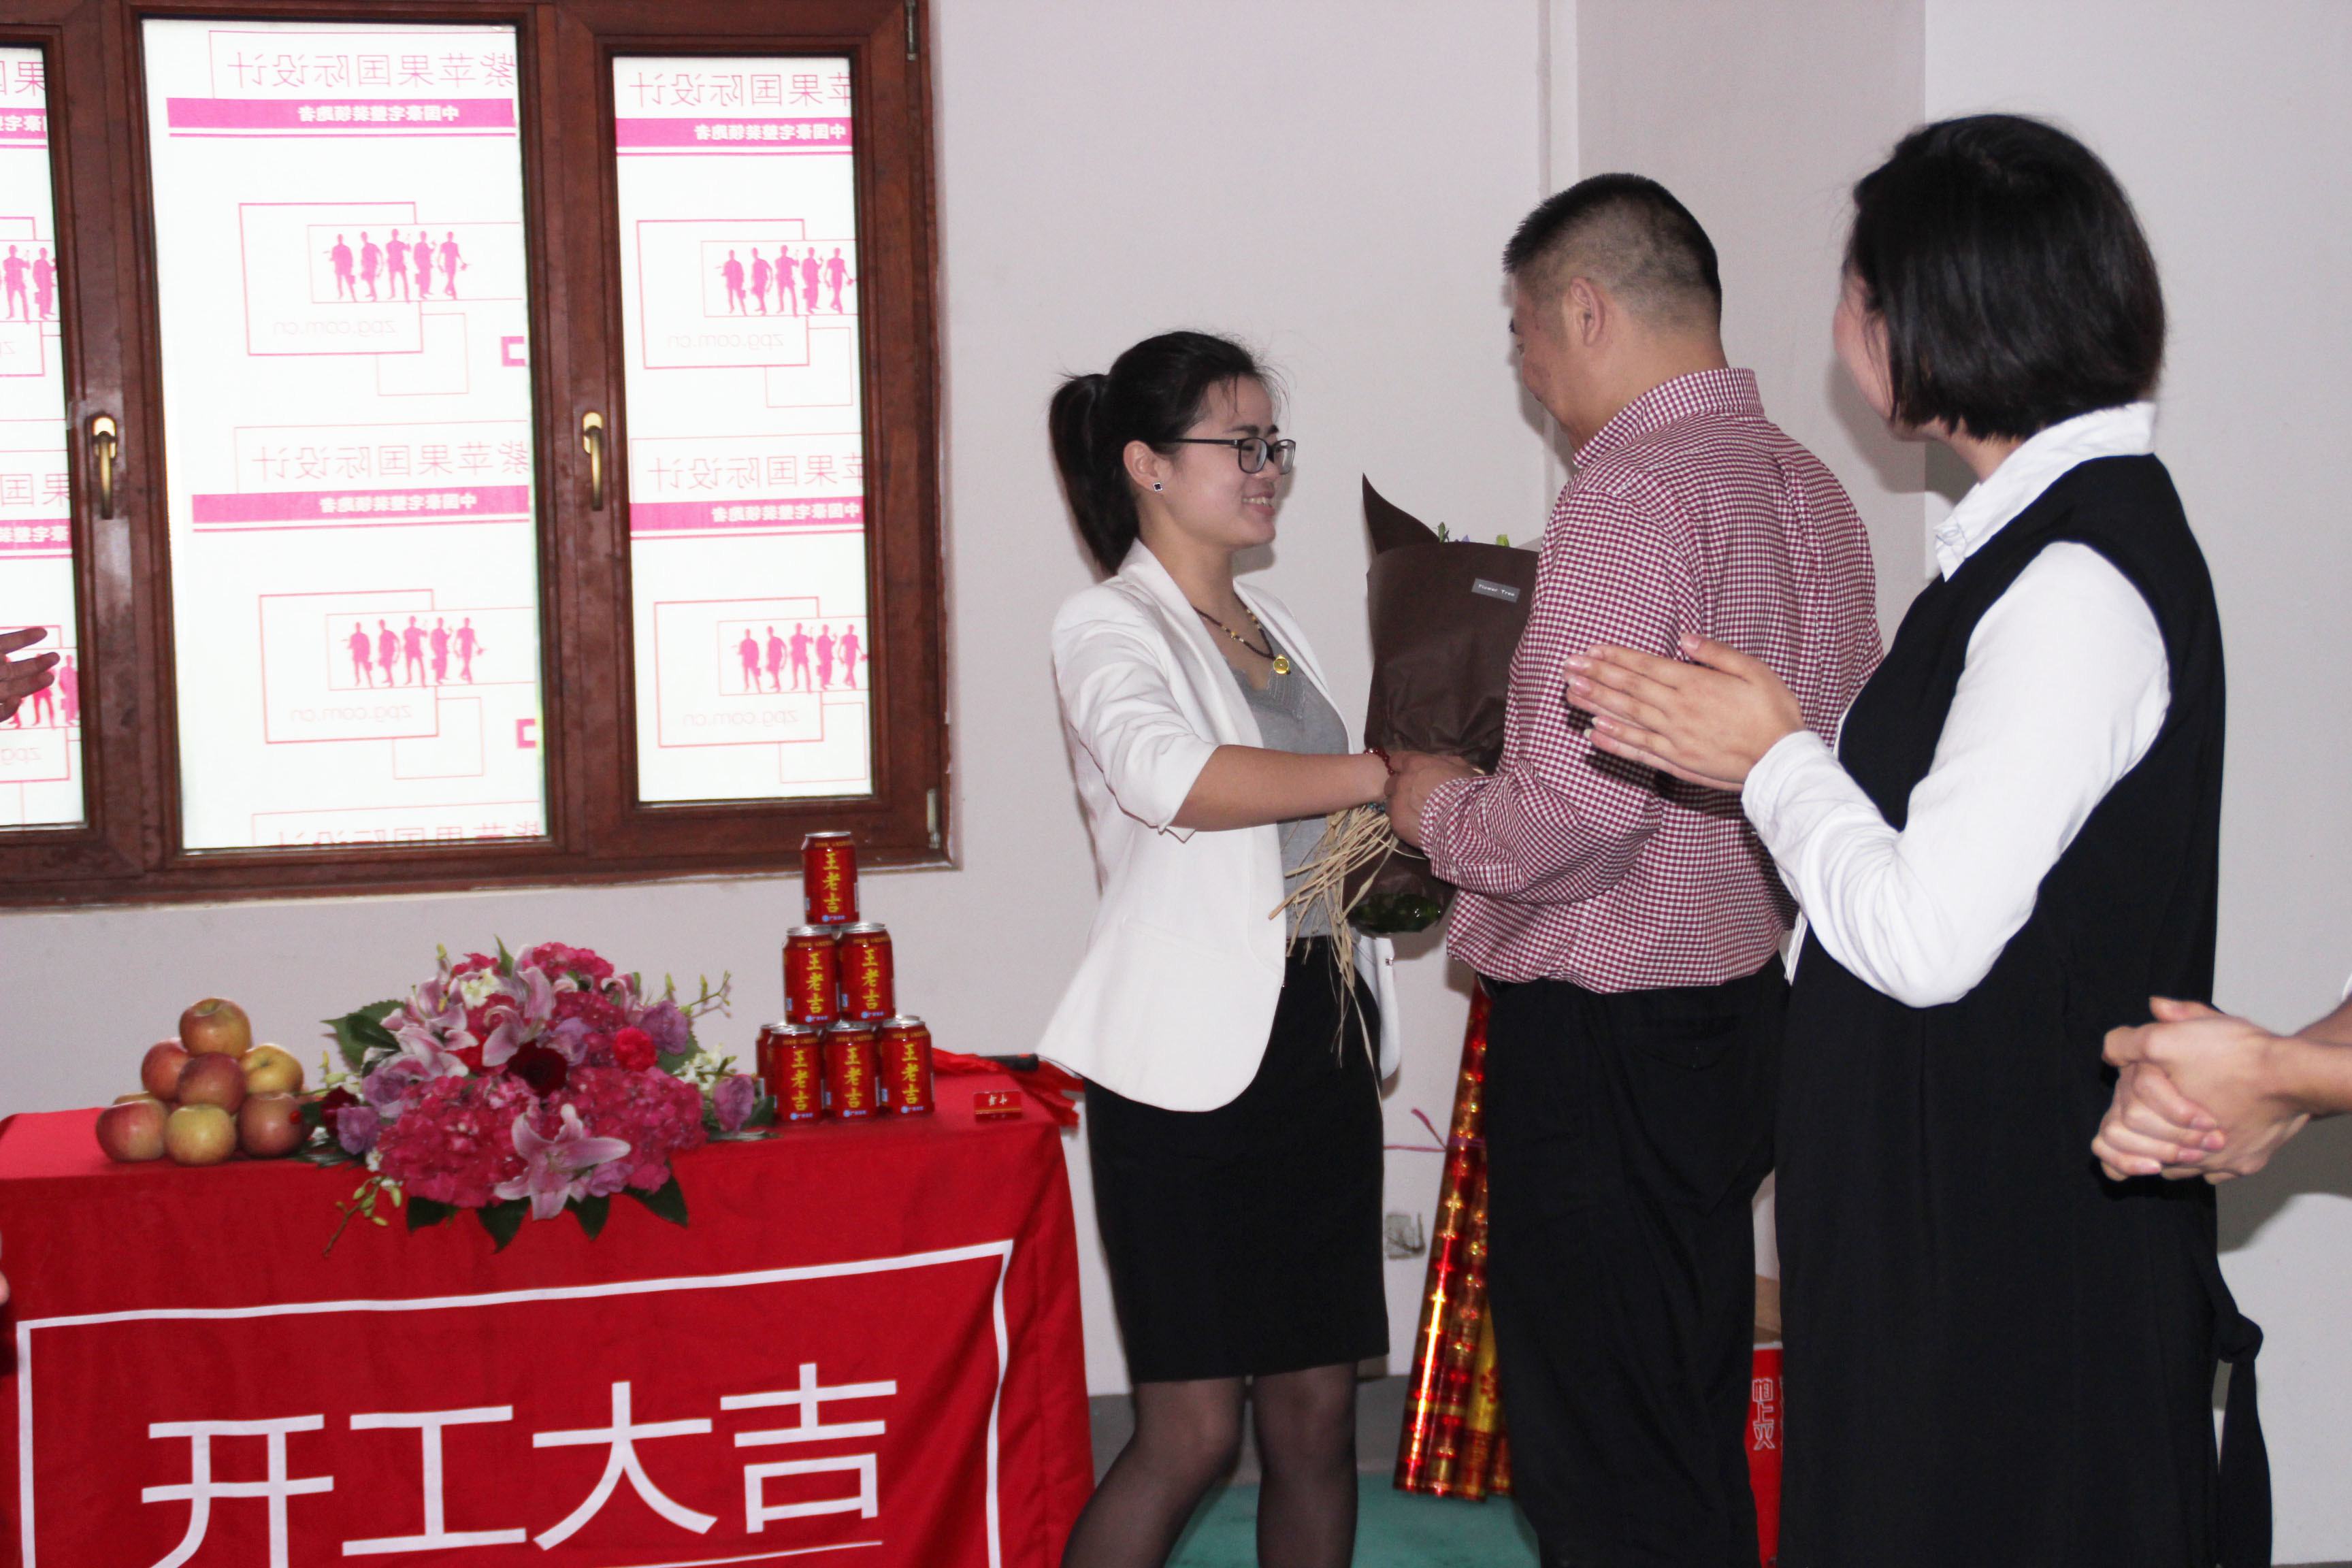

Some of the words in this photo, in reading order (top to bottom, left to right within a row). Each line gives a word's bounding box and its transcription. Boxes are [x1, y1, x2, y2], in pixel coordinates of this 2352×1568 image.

[822, 852, 841, 913] 王老吉
[806, 952, 824, 1013] 王老吉
[861, 946, 880, 1010] 王老吉
[791, 1049, 809, 1111] 王老吉
[844, 1047, 862, 1108] 王老吉
[901, 1043, 920, 1104] 王老吉
[141, 1362, 897, 1568] 开工大吉
